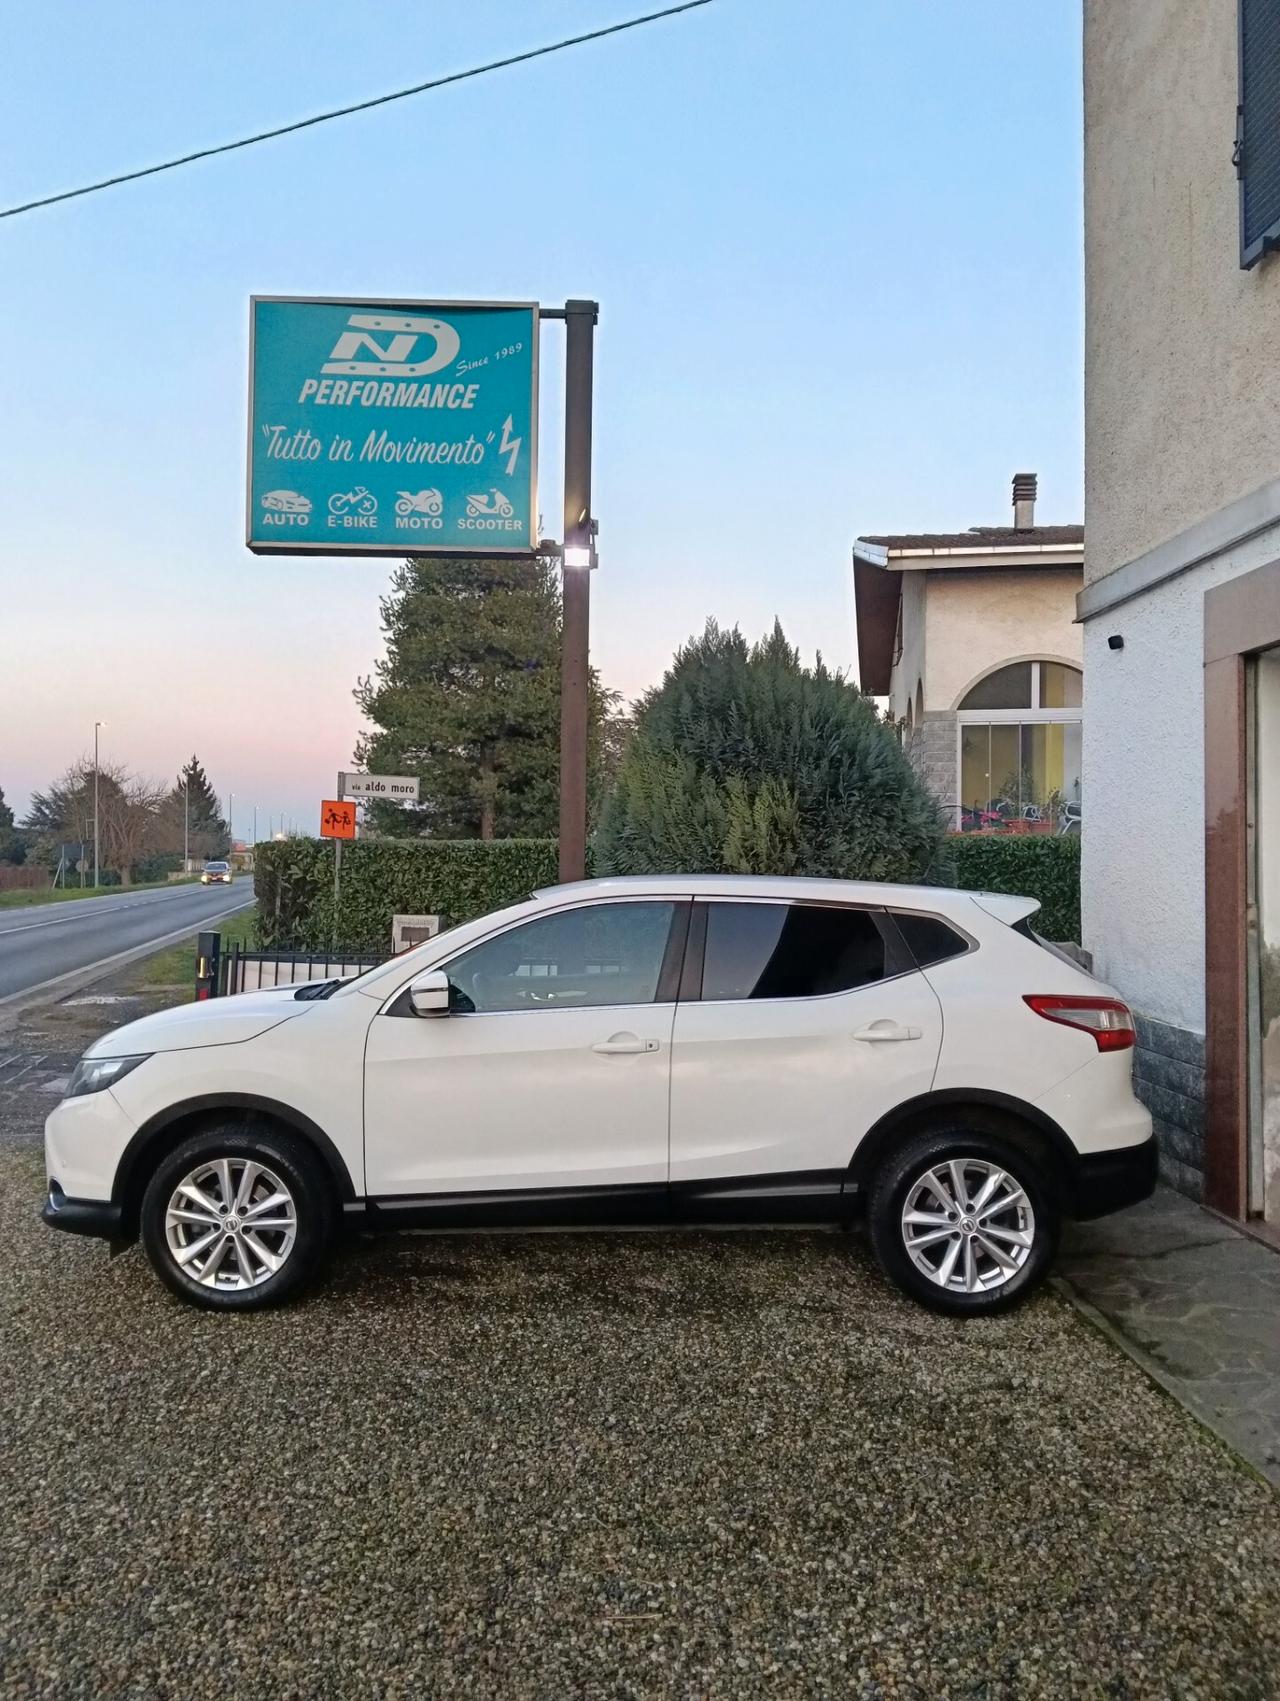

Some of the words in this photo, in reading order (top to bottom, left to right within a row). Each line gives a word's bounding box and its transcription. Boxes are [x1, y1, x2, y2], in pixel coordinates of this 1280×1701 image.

[455, 356, 489, 377] Since
[494, 342, 523, 361] 1989
[298, 378, 480, 409] PERFORMANCE
[262, 423, 321, 461] "Tutto
[328, 434, 354, 461] in
[359, 429, 496, 465] Movimento"
[262, 513, 309, 526] AUTO
[327, 516, 378, 528] E-BIKE
[395, 517, 443, 529] MOTO
[457, 518, 522, 531] SCOOTER
[365, 781, 386, 791] aldo
[391, 784, 415, 793] moro
